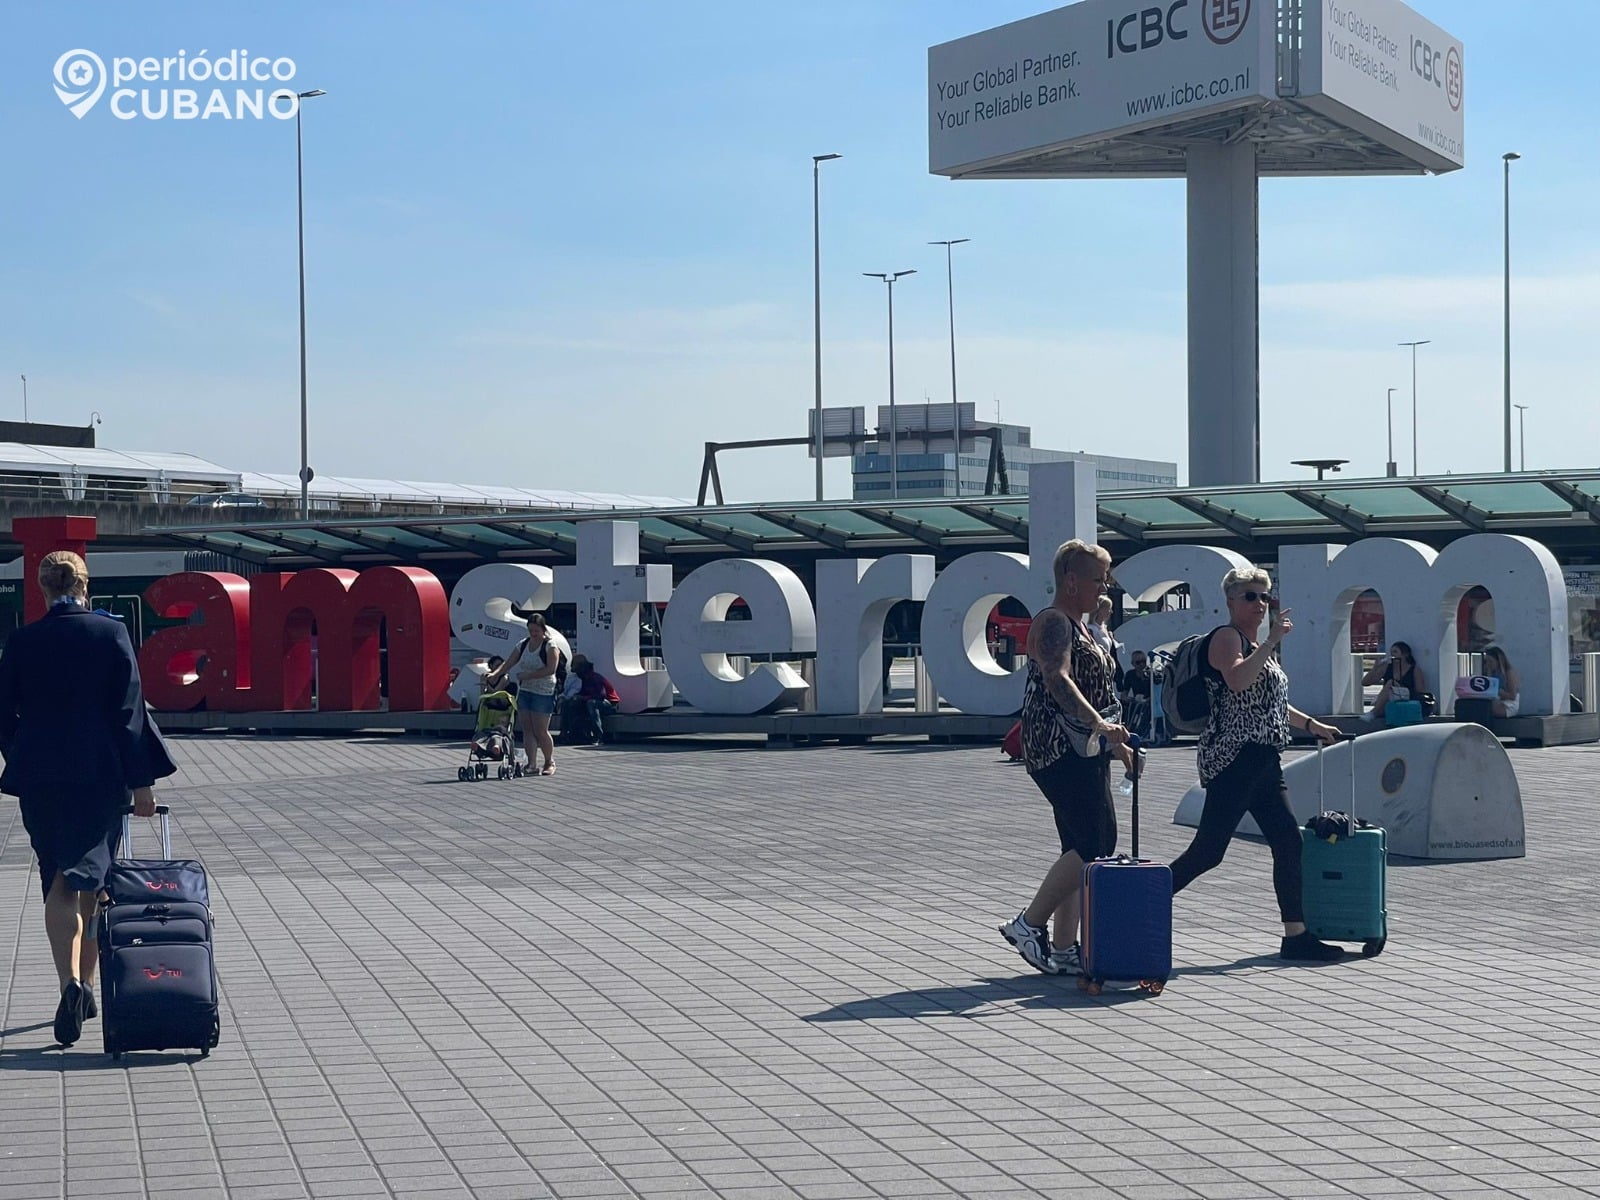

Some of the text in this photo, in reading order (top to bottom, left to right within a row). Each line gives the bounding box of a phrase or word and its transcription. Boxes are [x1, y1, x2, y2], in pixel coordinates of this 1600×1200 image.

[1107, 0, 1188, 59] ICBC
[1328, 0, 1400, 61] Your Global Partner.
[1328, 31, 1347, 62] Your
[1349, 43, 1378, 80] Reliable
[937, 50, 1081, 101] Your Global Partner.
[1409, 34, 1441, 88] ICBC
[937, 78, 1081, 130] Your Reliable Bank.
[1127, 66, 1249, 117] www.icbc.co.nl
